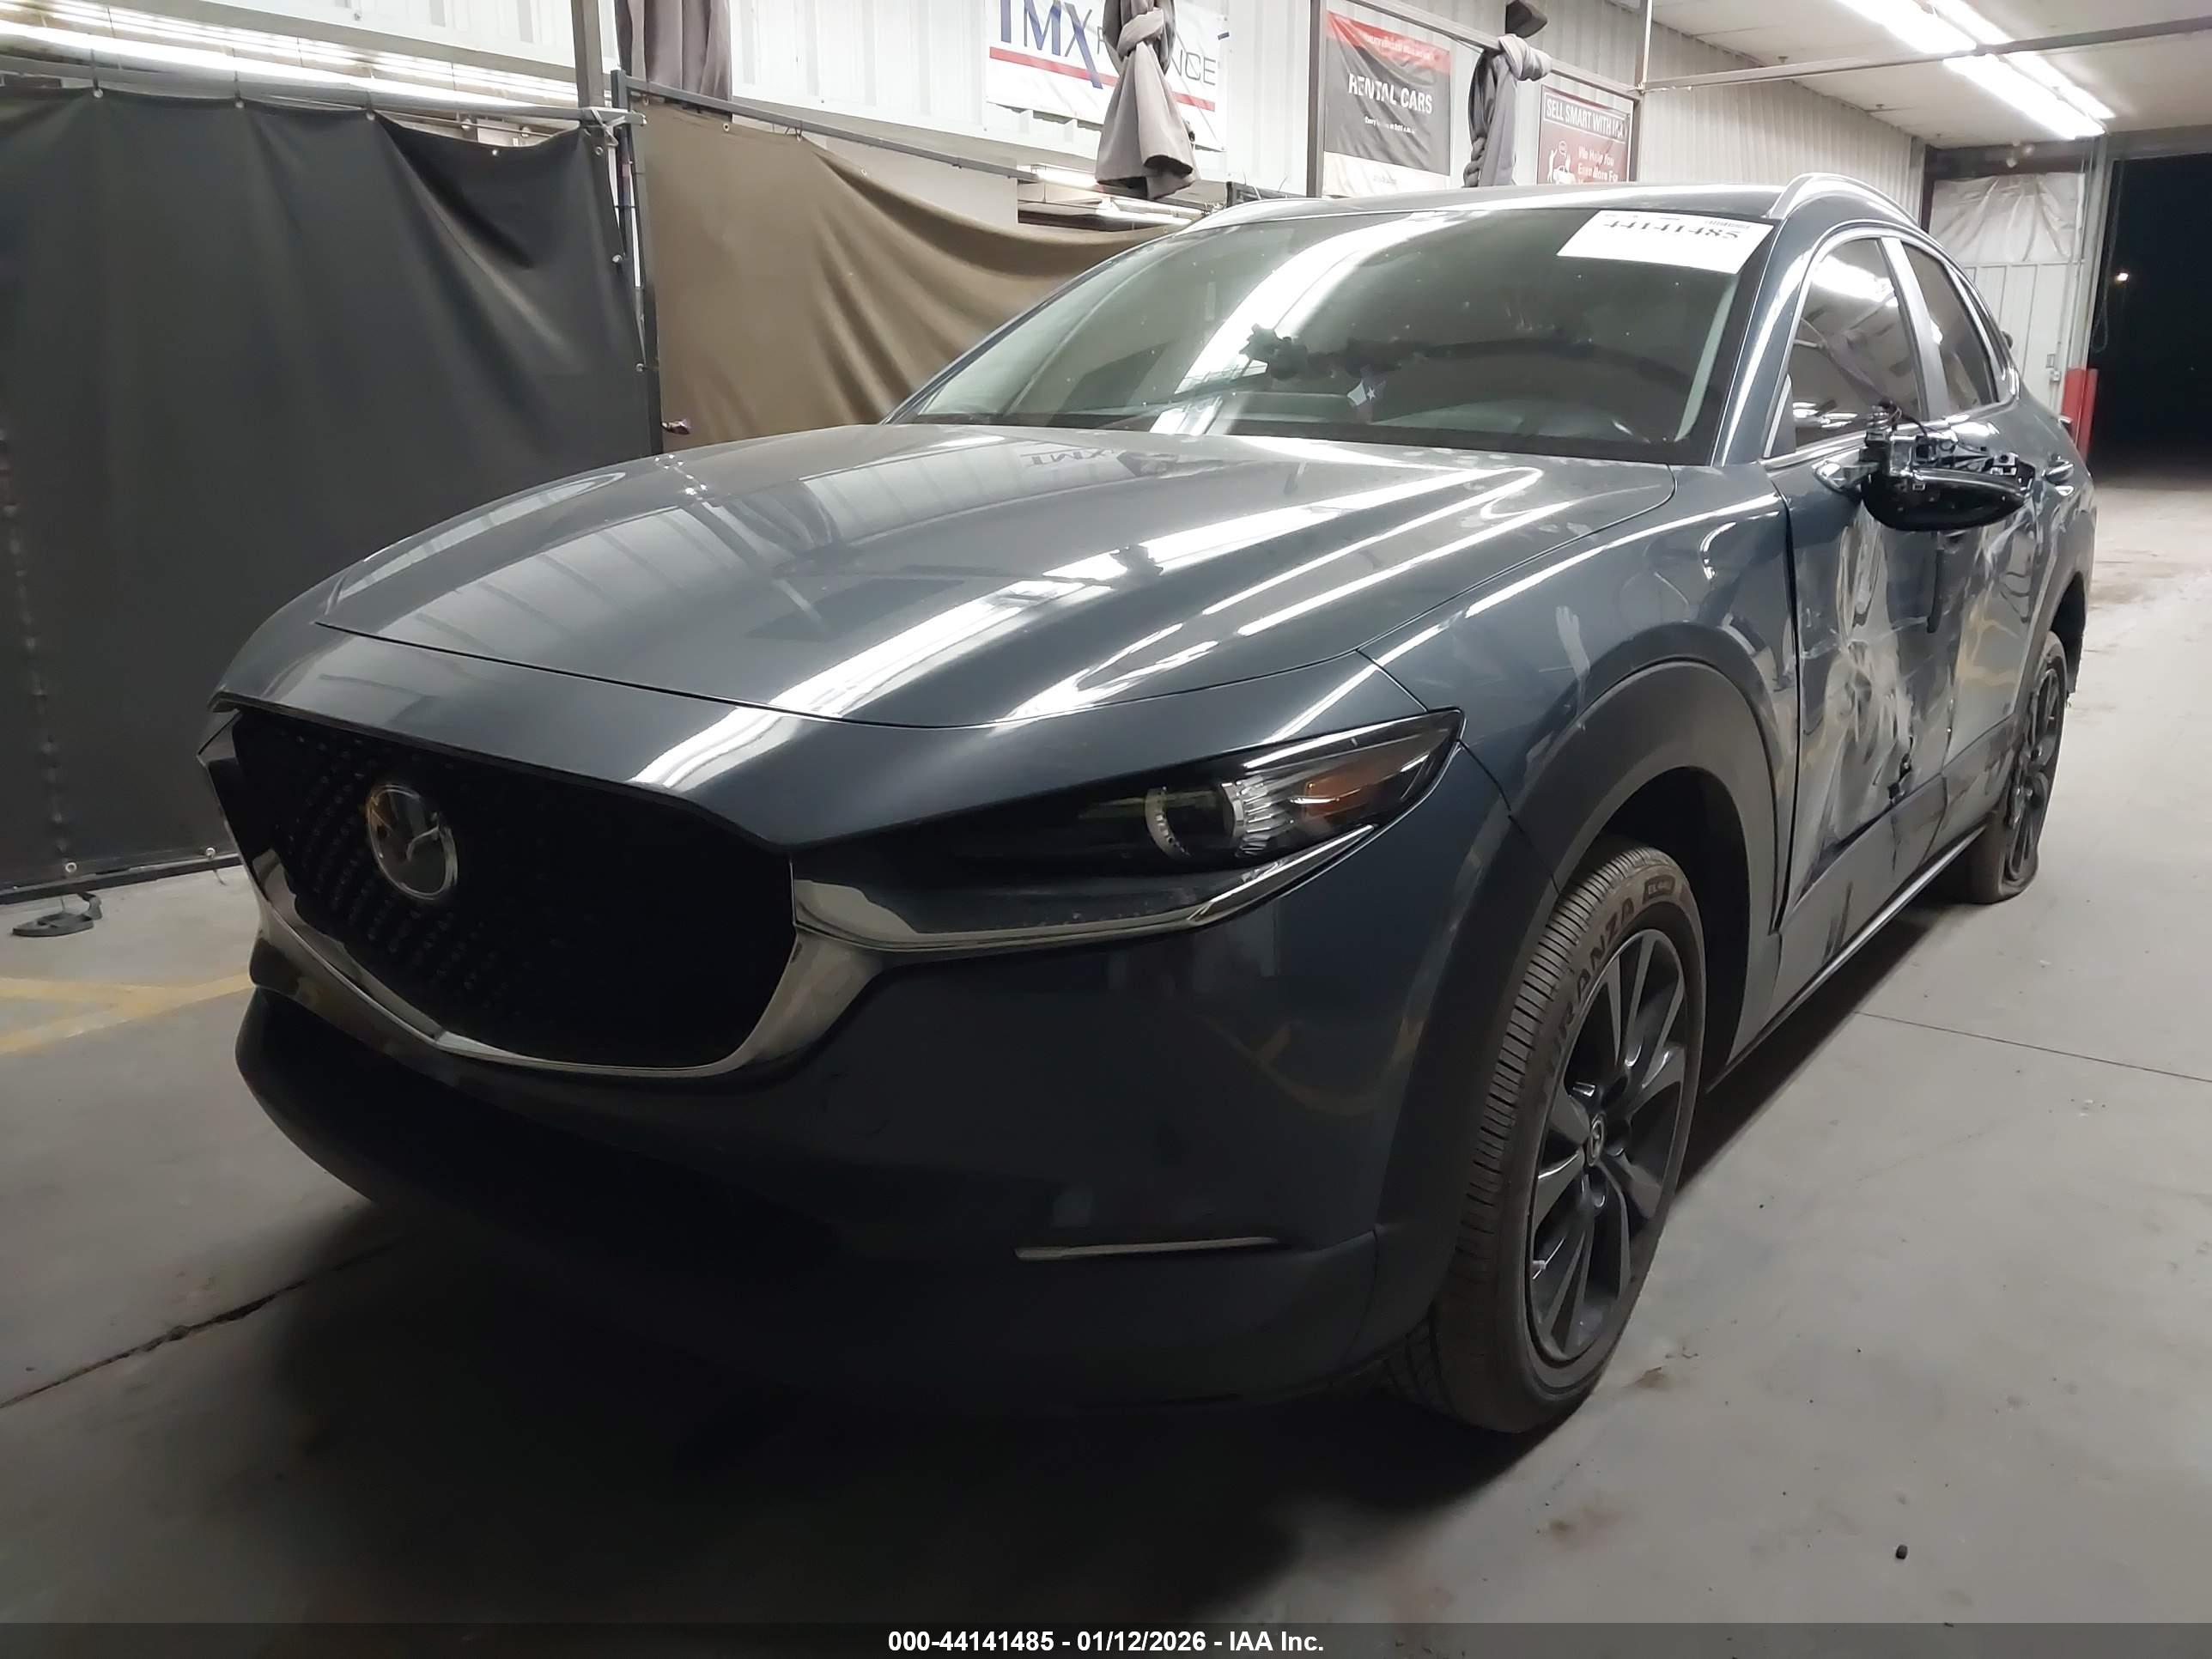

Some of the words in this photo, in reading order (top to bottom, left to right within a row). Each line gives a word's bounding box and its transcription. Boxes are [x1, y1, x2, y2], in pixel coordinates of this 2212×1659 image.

[1097, 26, 1217, 86] FNCE
[1348, 72, 1397, 106] RENTAL
[1401, 88, 1433, 114] CARS
[1547, 99, 1565, 120] SELL
[1565, 105, 1592, 130] SMART
[1592, 113, 1612, 137] WITH
[1593, 166, 1608, 180] More
[1604, 153, 1615, 167] You
[1603, 220, 1741, 240] 44141485
